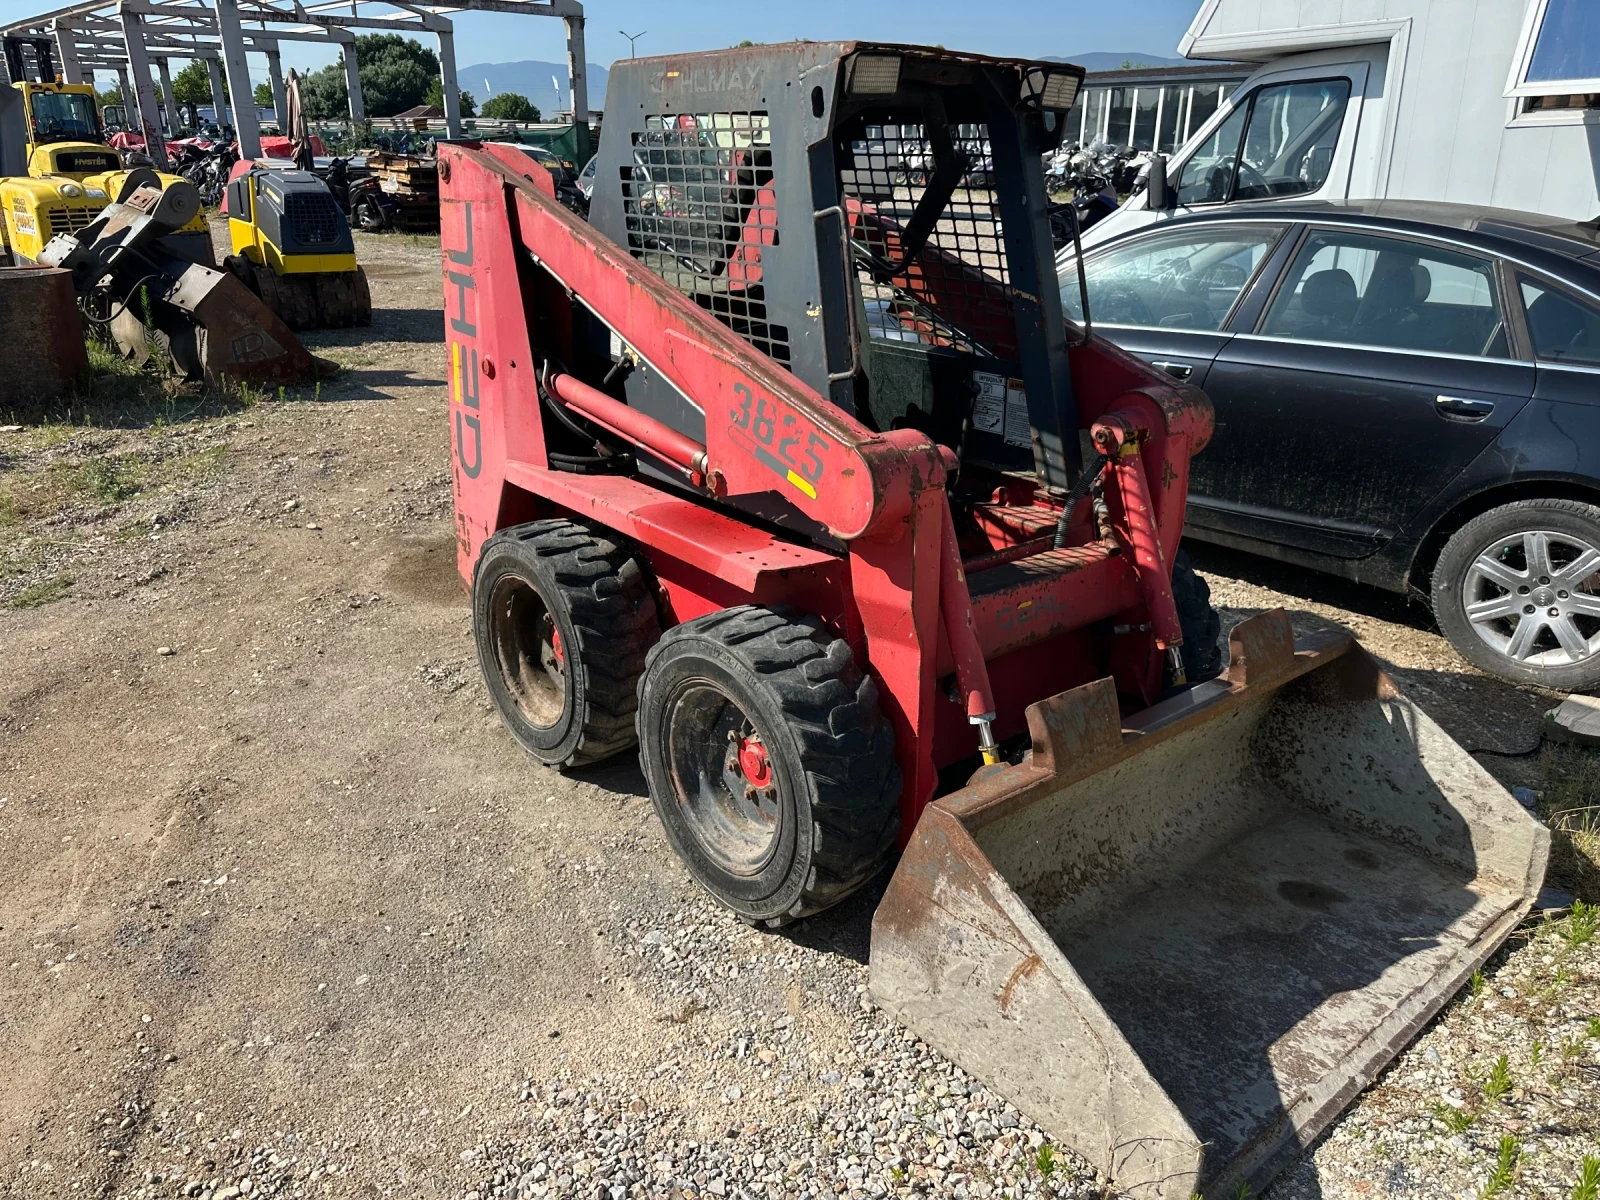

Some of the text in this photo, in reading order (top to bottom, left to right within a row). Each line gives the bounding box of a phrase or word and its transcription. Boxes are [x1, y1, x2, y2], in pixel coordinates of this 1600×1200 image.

[74, 156, 107, 166] HYSTER
[448, 202, 482, 480] GEHL
[729, 381, 830, 484] 3825
[995, 593, 1067, 631] GEHL
